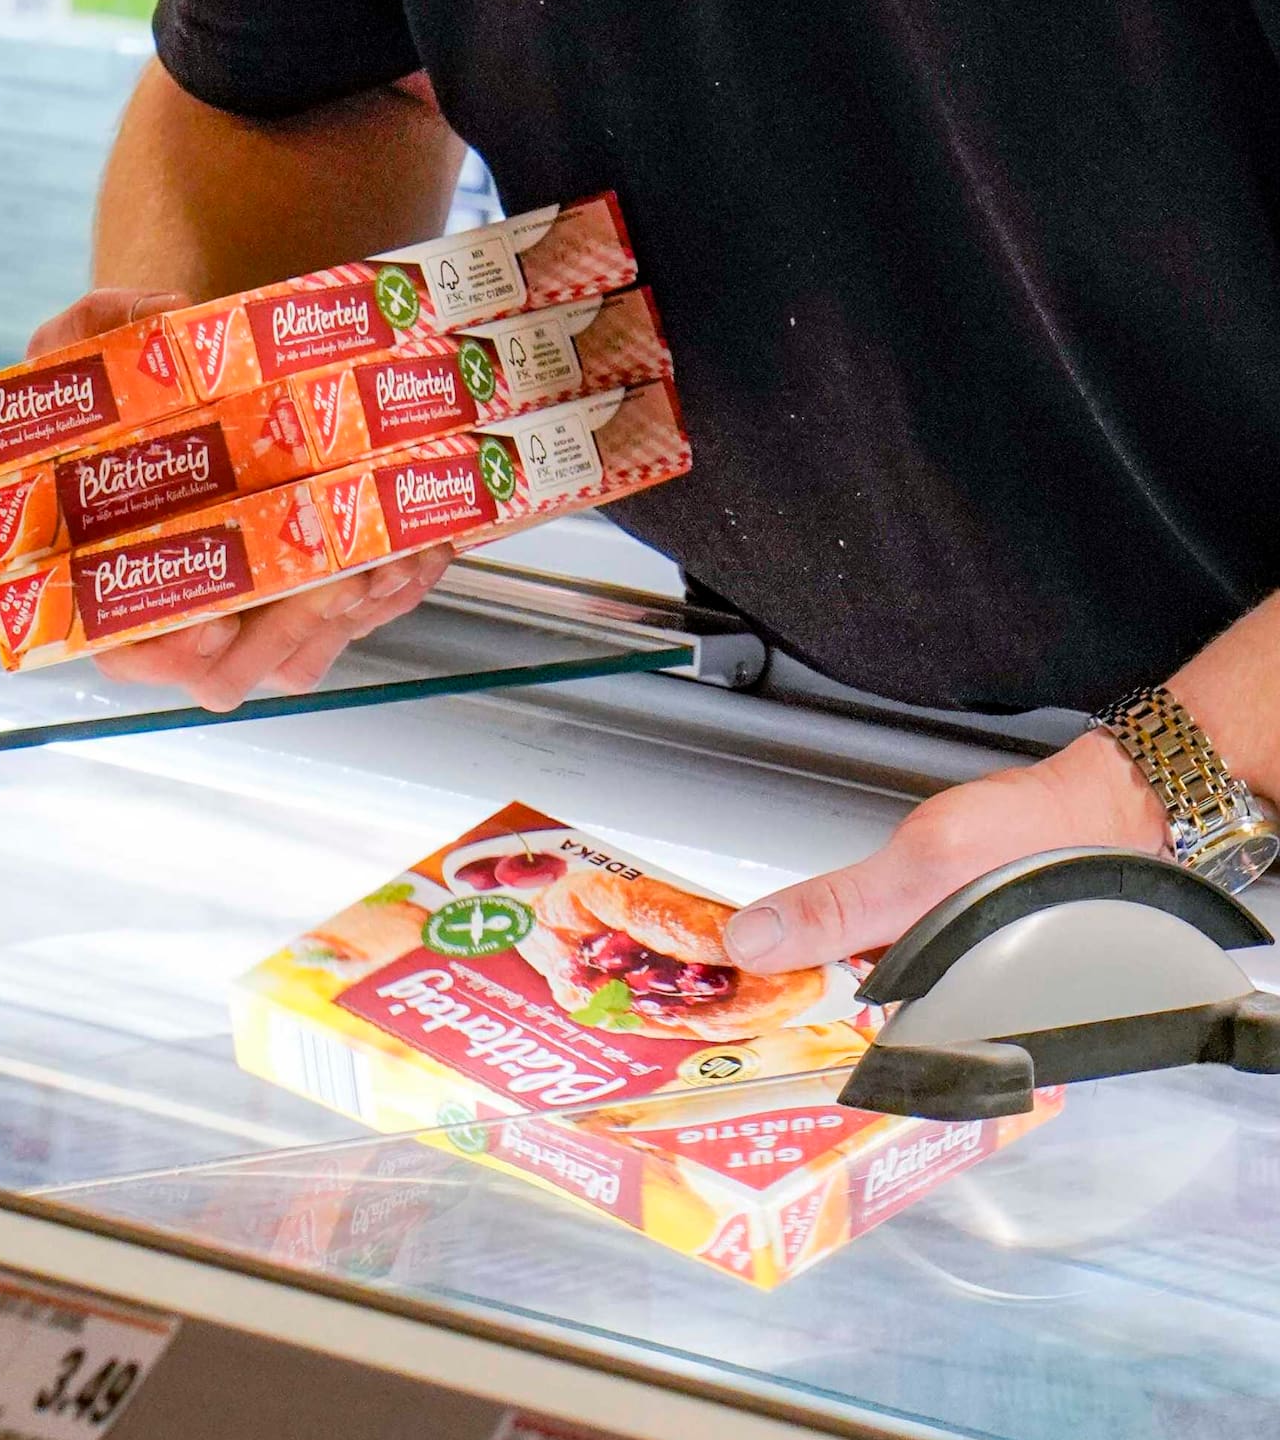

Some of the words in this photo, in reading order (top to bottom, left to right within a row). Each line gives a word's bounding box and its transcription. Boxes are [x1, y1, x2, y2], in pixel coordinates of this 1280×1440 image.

[446, 290, 464, 304] FSC
[195, 323, 207, 351] GUT
[273, 296, 370, 346] Blätterteig
[376, 367, 456, 410] Blätterteig
[9, 432, 22, 447] und
[79, 442, 210, 508] Blätterteig
[396, 468, 476, 514] Blätterteig
[95, 540, 227, 603] Blätterteig
[1, 584, 18, 613] GUT
[129, 599, 146, 613] und
[560, 839, 644, 881] EDEKA
[376, 969, 627, 1105] Blätterteig
[677, 1114, 844, 1145] GÜNSTIG
[754, 1133, 777, 1148] &
[726, 1146, 803, 1168] GUT
[34, 1346, 144, 1425] 3.49
